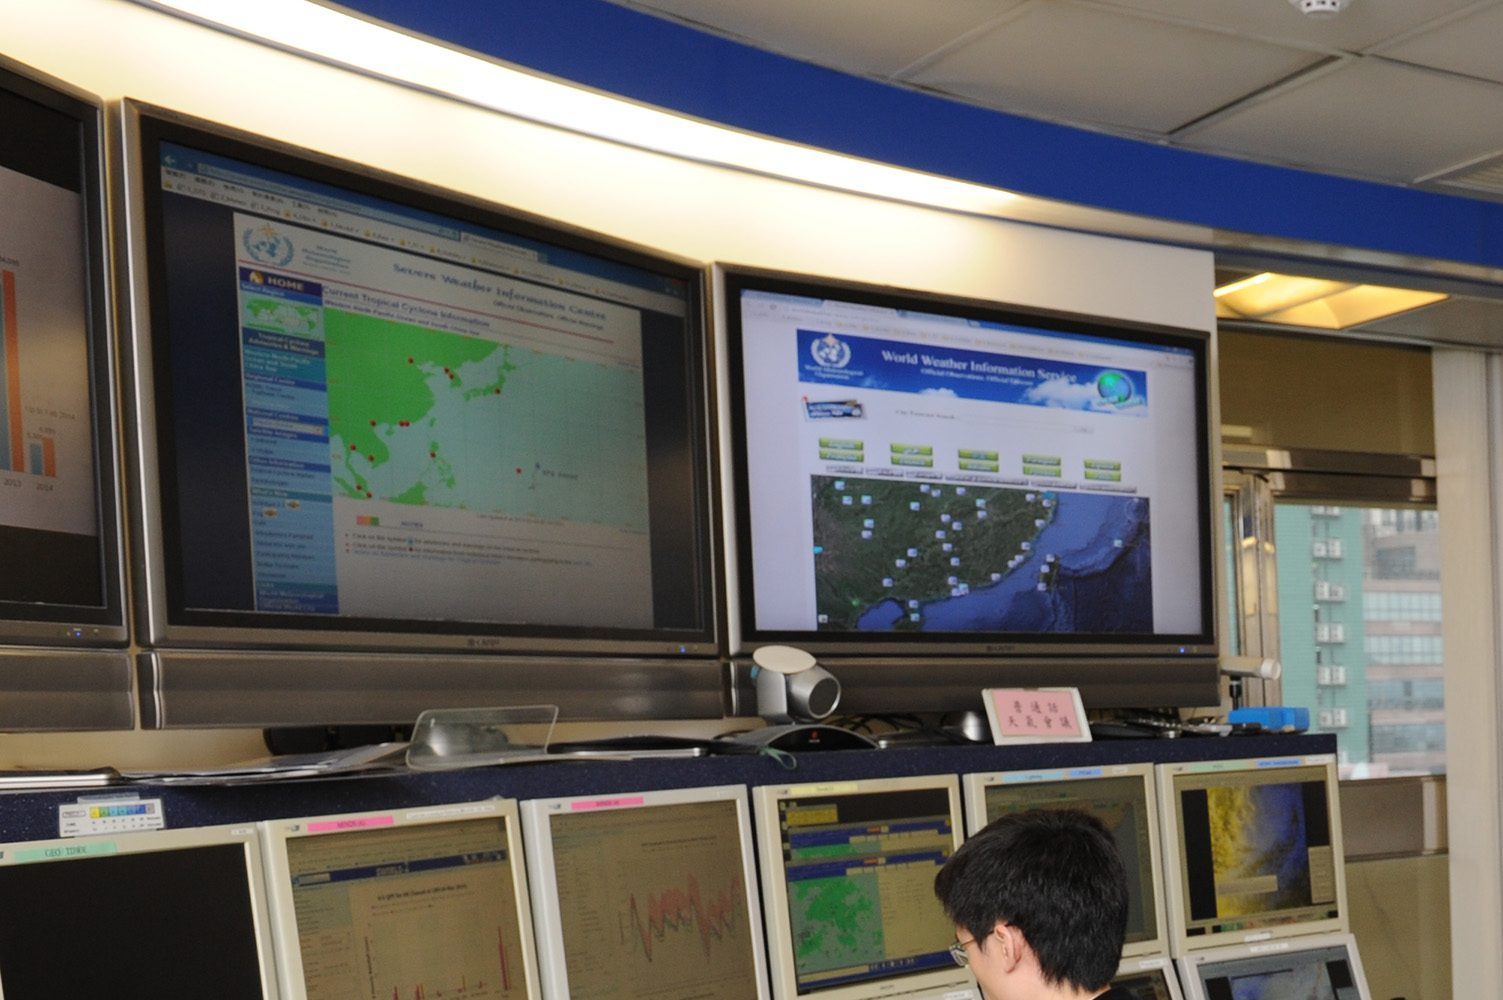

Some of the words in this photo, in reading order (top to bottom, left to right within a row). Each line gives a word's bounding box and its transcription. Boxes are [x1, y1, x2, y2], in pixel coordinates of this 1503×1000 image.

[267, 276, 304, 291] HOME
[394, 264, 436, 280] Severe
[441, 273, 492, 294] Weather
[496, 282, 566, 312] Information
[323, 286, 359, 300] Current
[362, 293, 400, 309] Tropical
[402, 300, 438, 318] Cyclone
[441, 307, 490, 327] Information
[881, 350, 918, 366] World
[921, 354, 967, 371] Weather
[970, 360, 1035, 379] Information
[1037, 368, 1077, 384] Service
[1013, 700, 1058, 714] 普通話
[1008, 715, 1073, 729] 天氣會議
